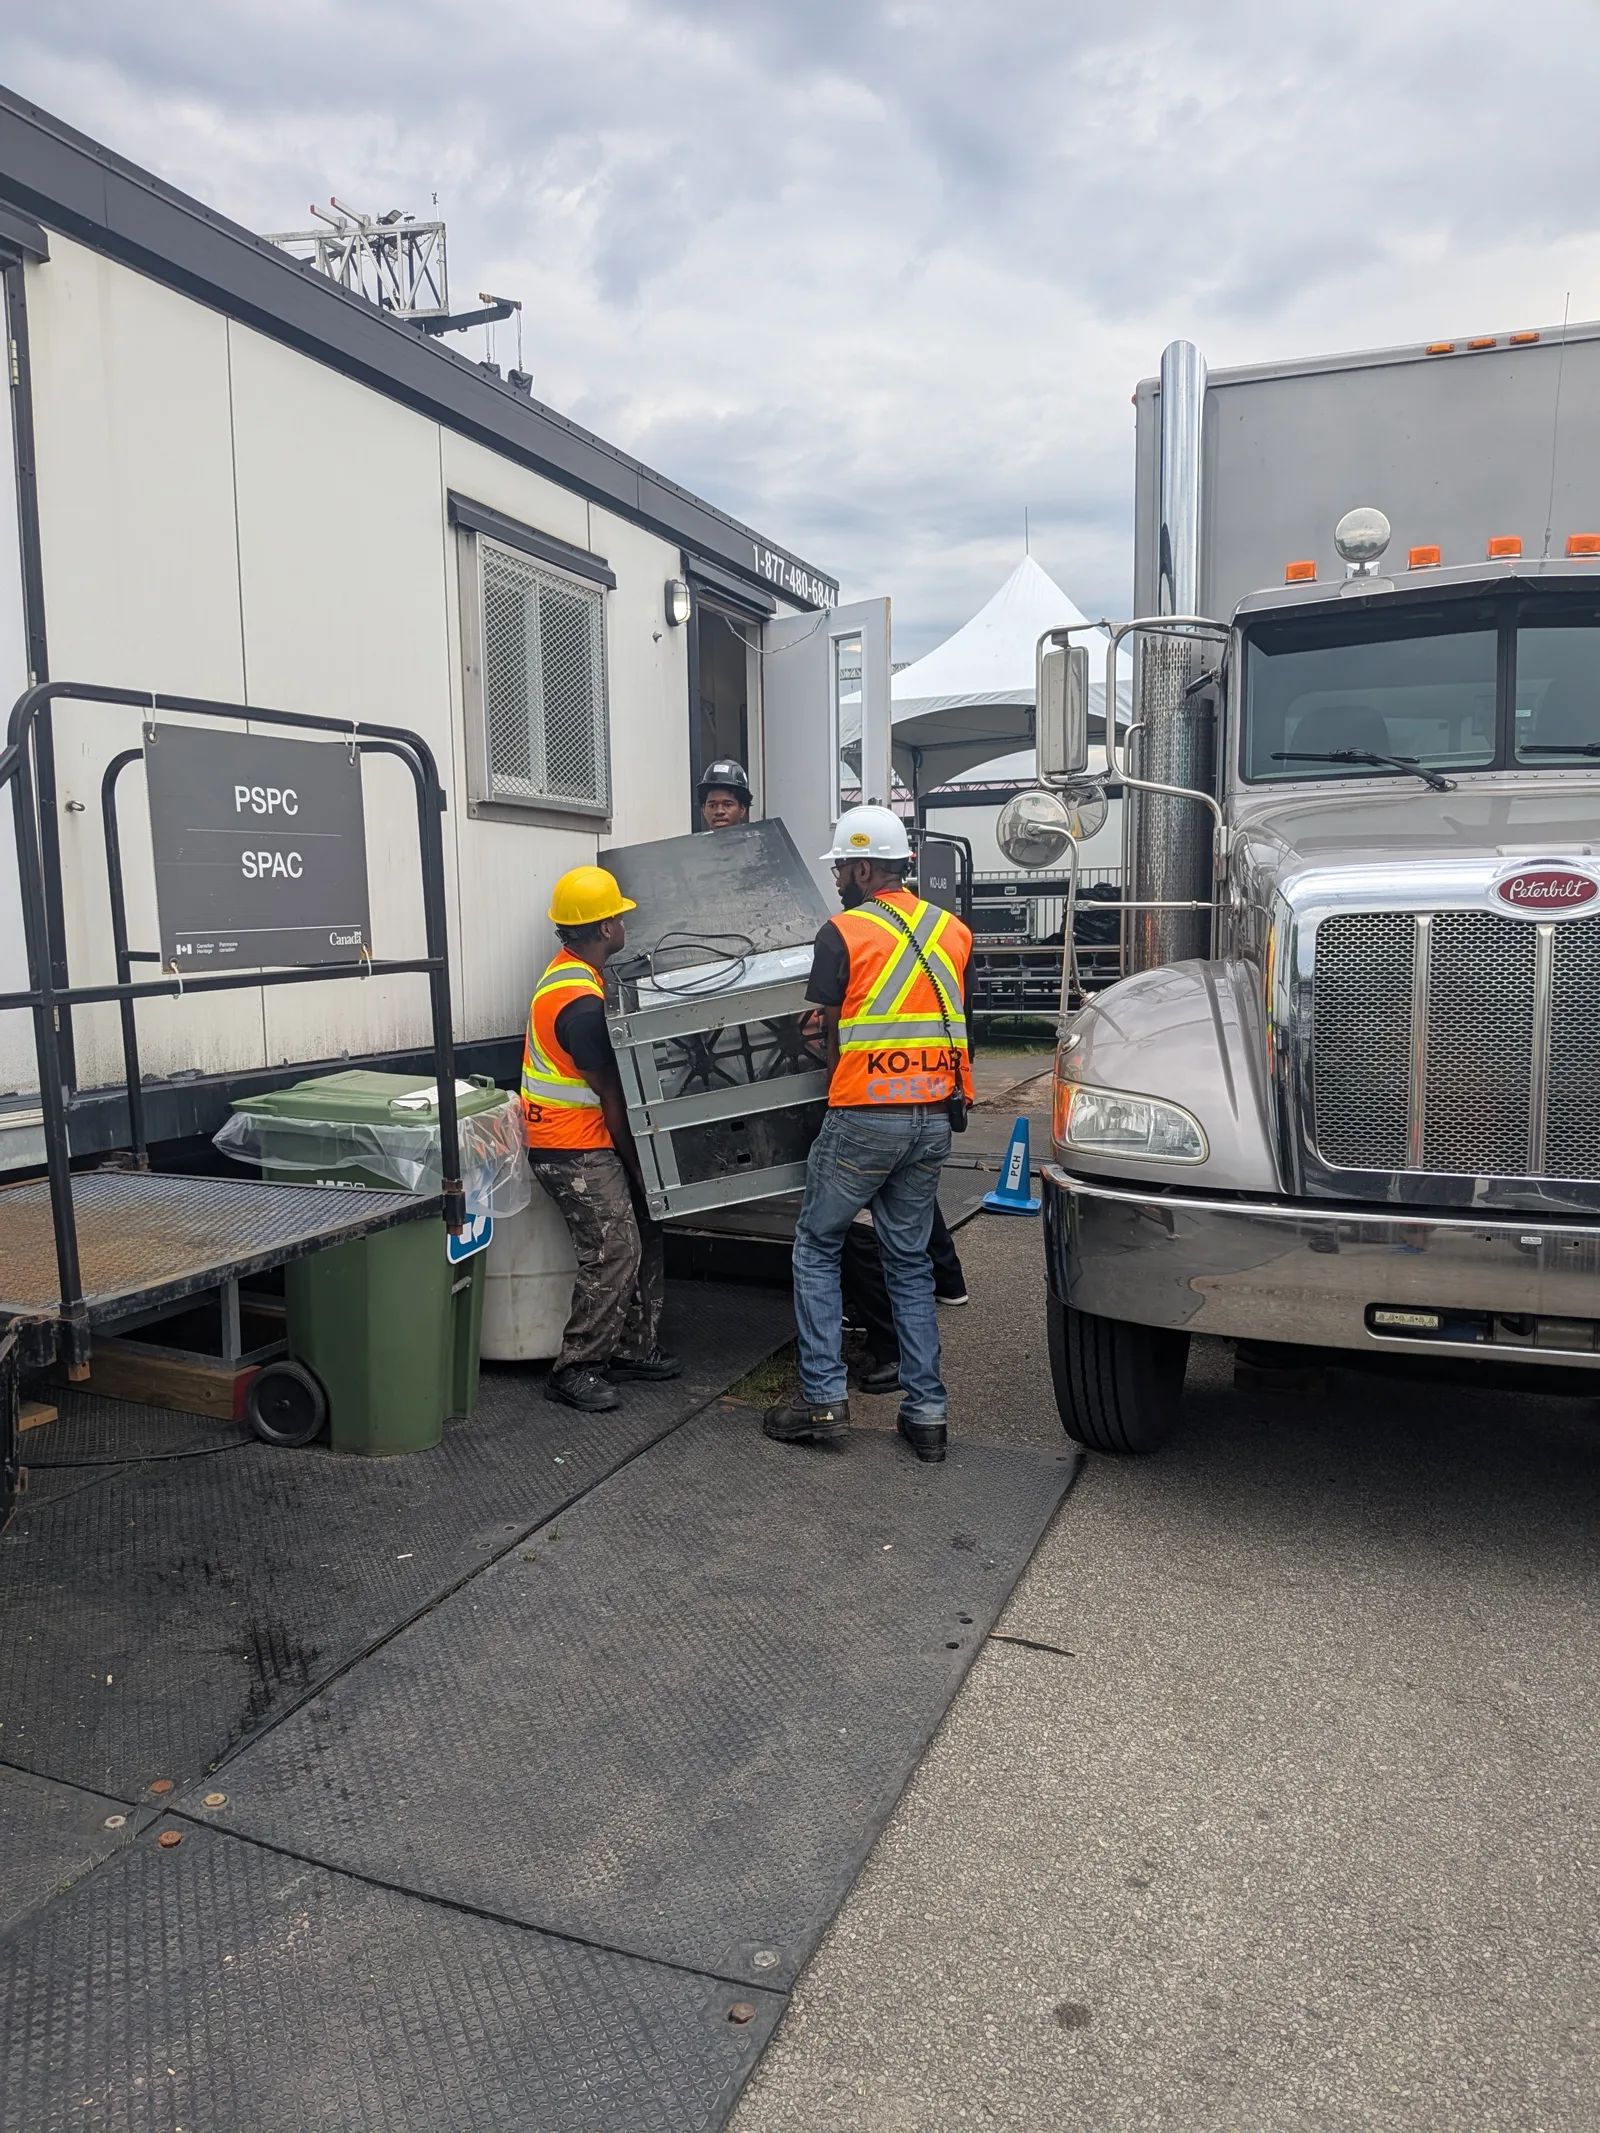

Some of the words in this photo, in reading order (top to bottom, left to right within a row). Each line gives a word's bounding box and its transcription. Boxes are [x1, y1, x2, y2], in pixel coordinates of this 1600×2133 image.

[753, 544, 836, 609] 1-877-480-6844
[234, 785, 299, 816] PSPC
[241, 850, 304, 879] SPAC
[929, 876, 947, 890] KO-LAB
[1509, 878, 1590, 900] Peterbilt
[329, 931, 362, 946] Canada
[867, 1050, 963, 1075] KO-LAB
[866, 1074, 947, 1103] CREW
[1010, 1154, 1022, 1177] PCH
